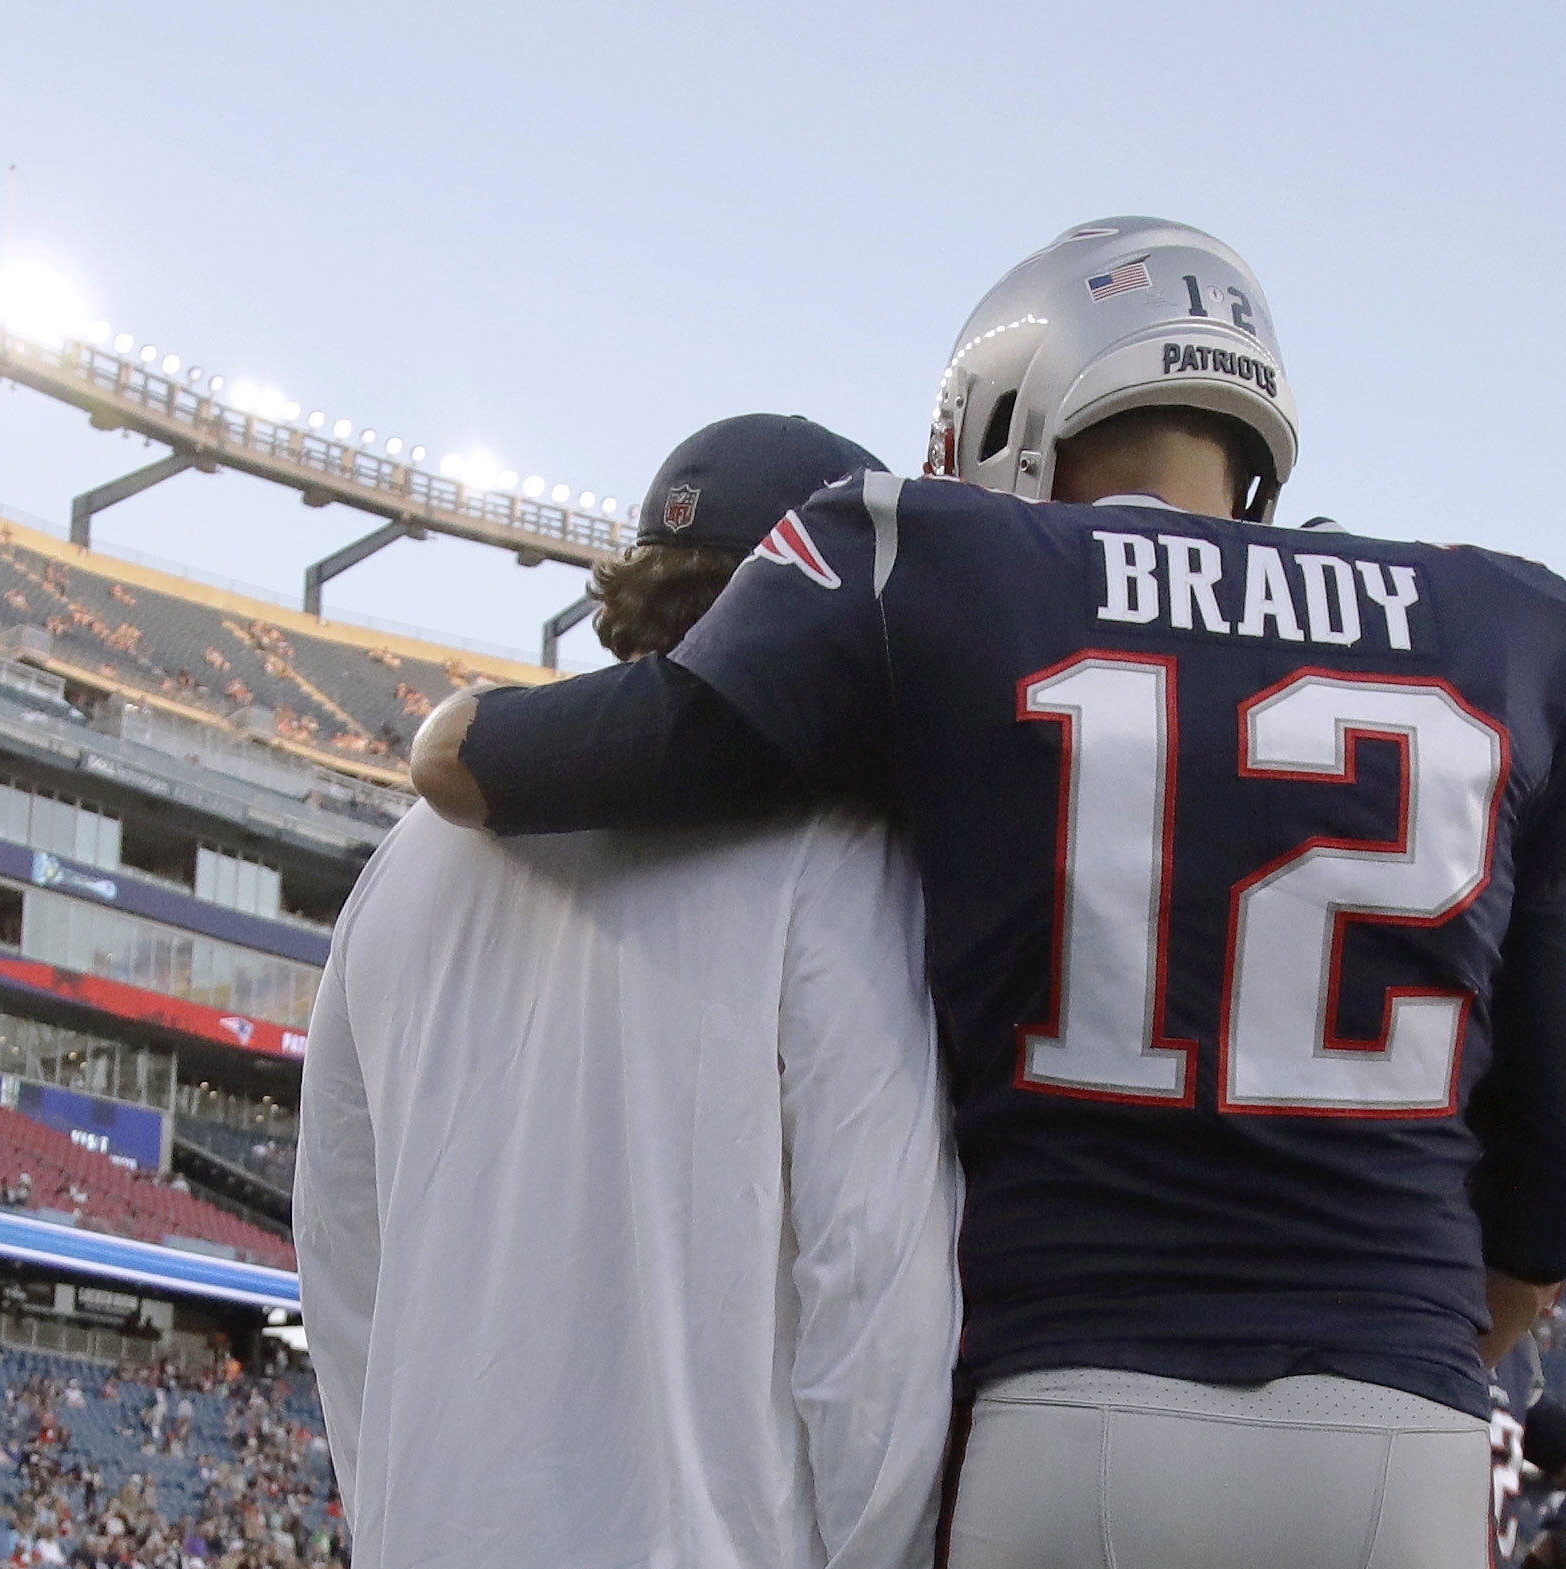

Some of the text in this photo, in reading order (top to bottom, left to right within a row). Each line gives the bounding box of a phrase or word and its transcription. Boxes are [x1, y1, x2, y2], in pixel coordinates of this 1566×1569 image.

[1163, 343, 1278, 398] PATRIOTS
[1092, 530, 1418, 650] BRADY
[1014, 648, 1510, 1118] 12
